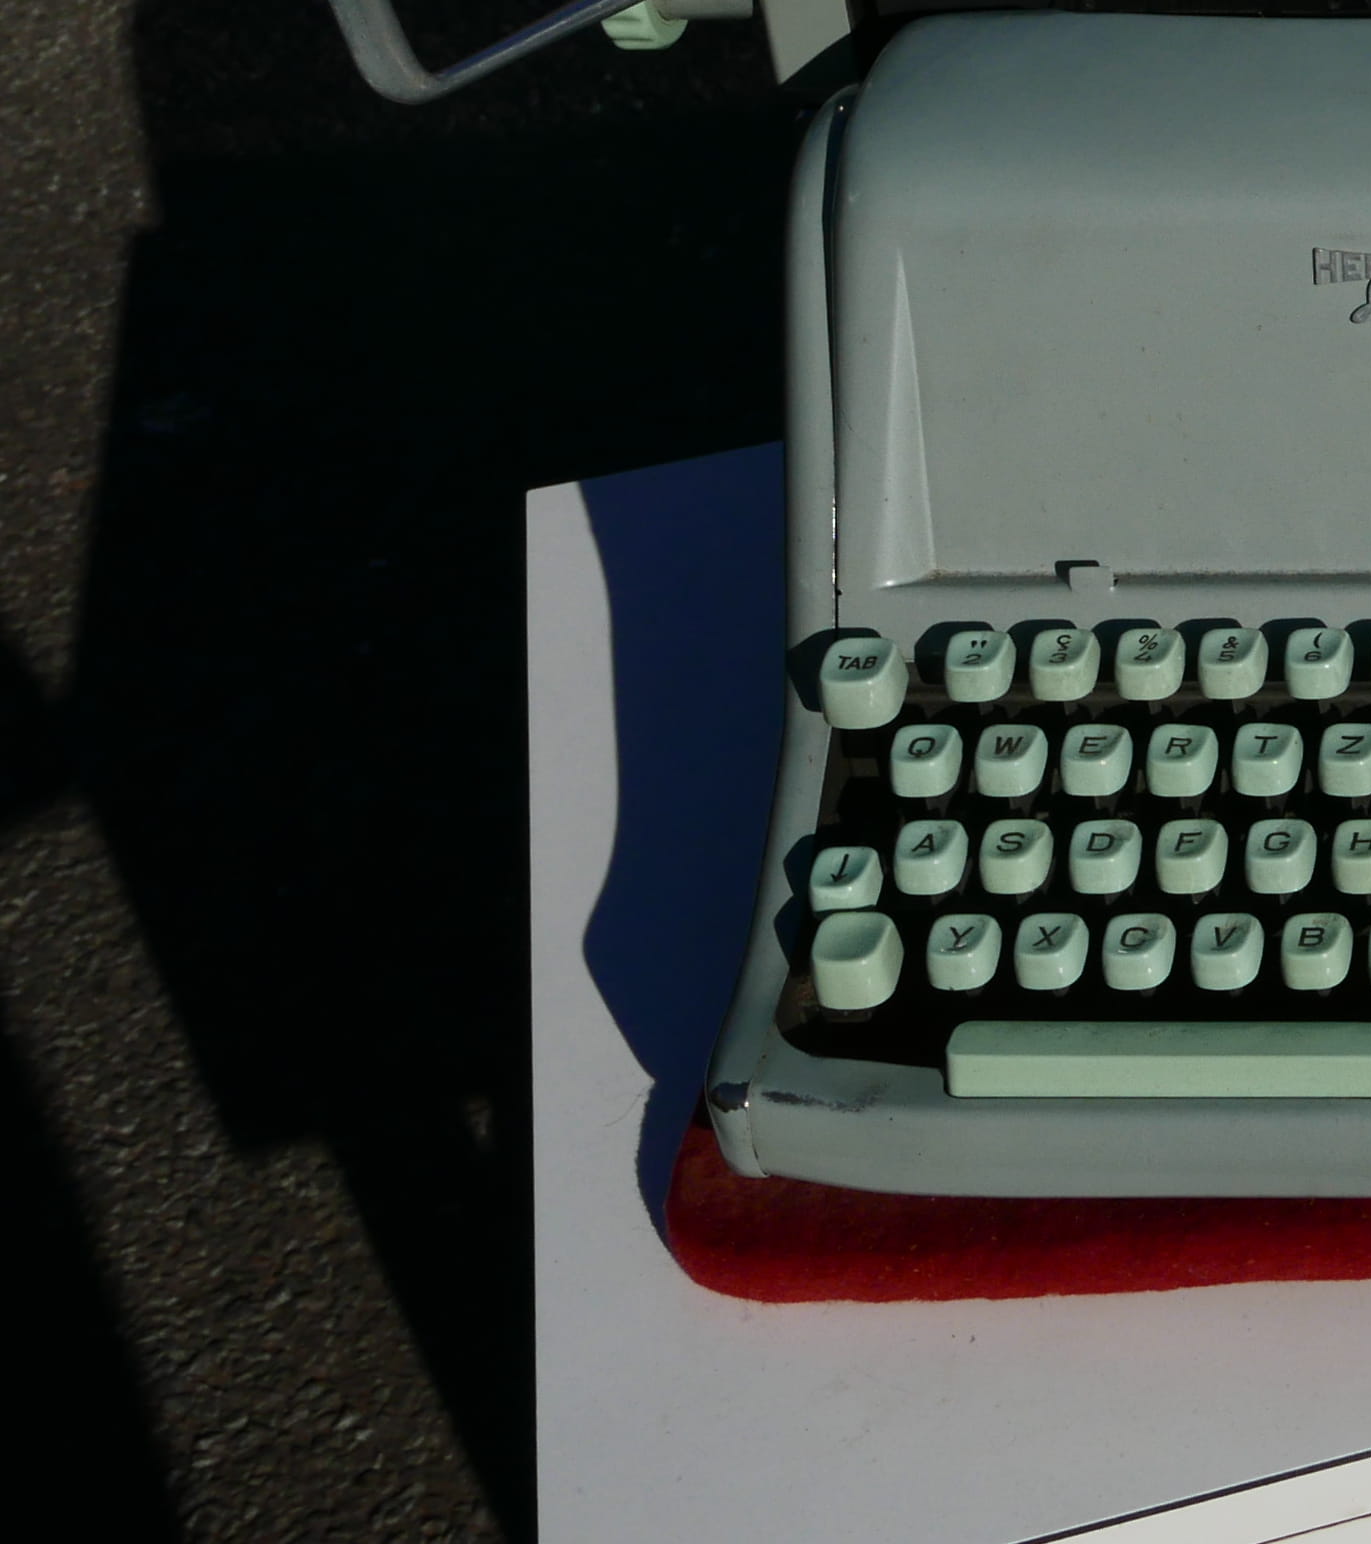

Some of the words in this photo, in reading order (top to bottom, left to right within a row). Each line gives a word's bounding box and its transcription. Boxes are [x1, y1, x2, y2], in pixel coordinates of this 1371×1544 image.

[1138, 633, 1158, 651] %
[1222, 635, 1239, 649] &
[838, 655, 878, 670] TAB
[960, 653, 983, 666] 2
[1047, 652, 1068, 664] 3
[1133, 651, 1153, 663] 4
[1215, 650, 1236, 663] 5
[1303, 650, 1323, 662] 6
[907, 736, 936, 758] Q
[994, 735, 1024, 755] W
[1078, 736, 1108, 757] E
[1164, 736, 1193, 756] R
[1254, 735, 1278, 755] T
[1335, 735, 1365, 755] Z
[911, 833, 936, 854] A
[996, 831, 1025, 853] S
[1086, 832, 1115, 852] D
[1174, 831, 1203, 853] F
[1263, 831, 1291, 852] G
[947, 926, 975, 950] Y
[1032, 925, 1062, 948] X
[1119, 926, 1149, 950] C
[1210, 926, 1238, 948] V
[1298, 926, 1325, 947] B
